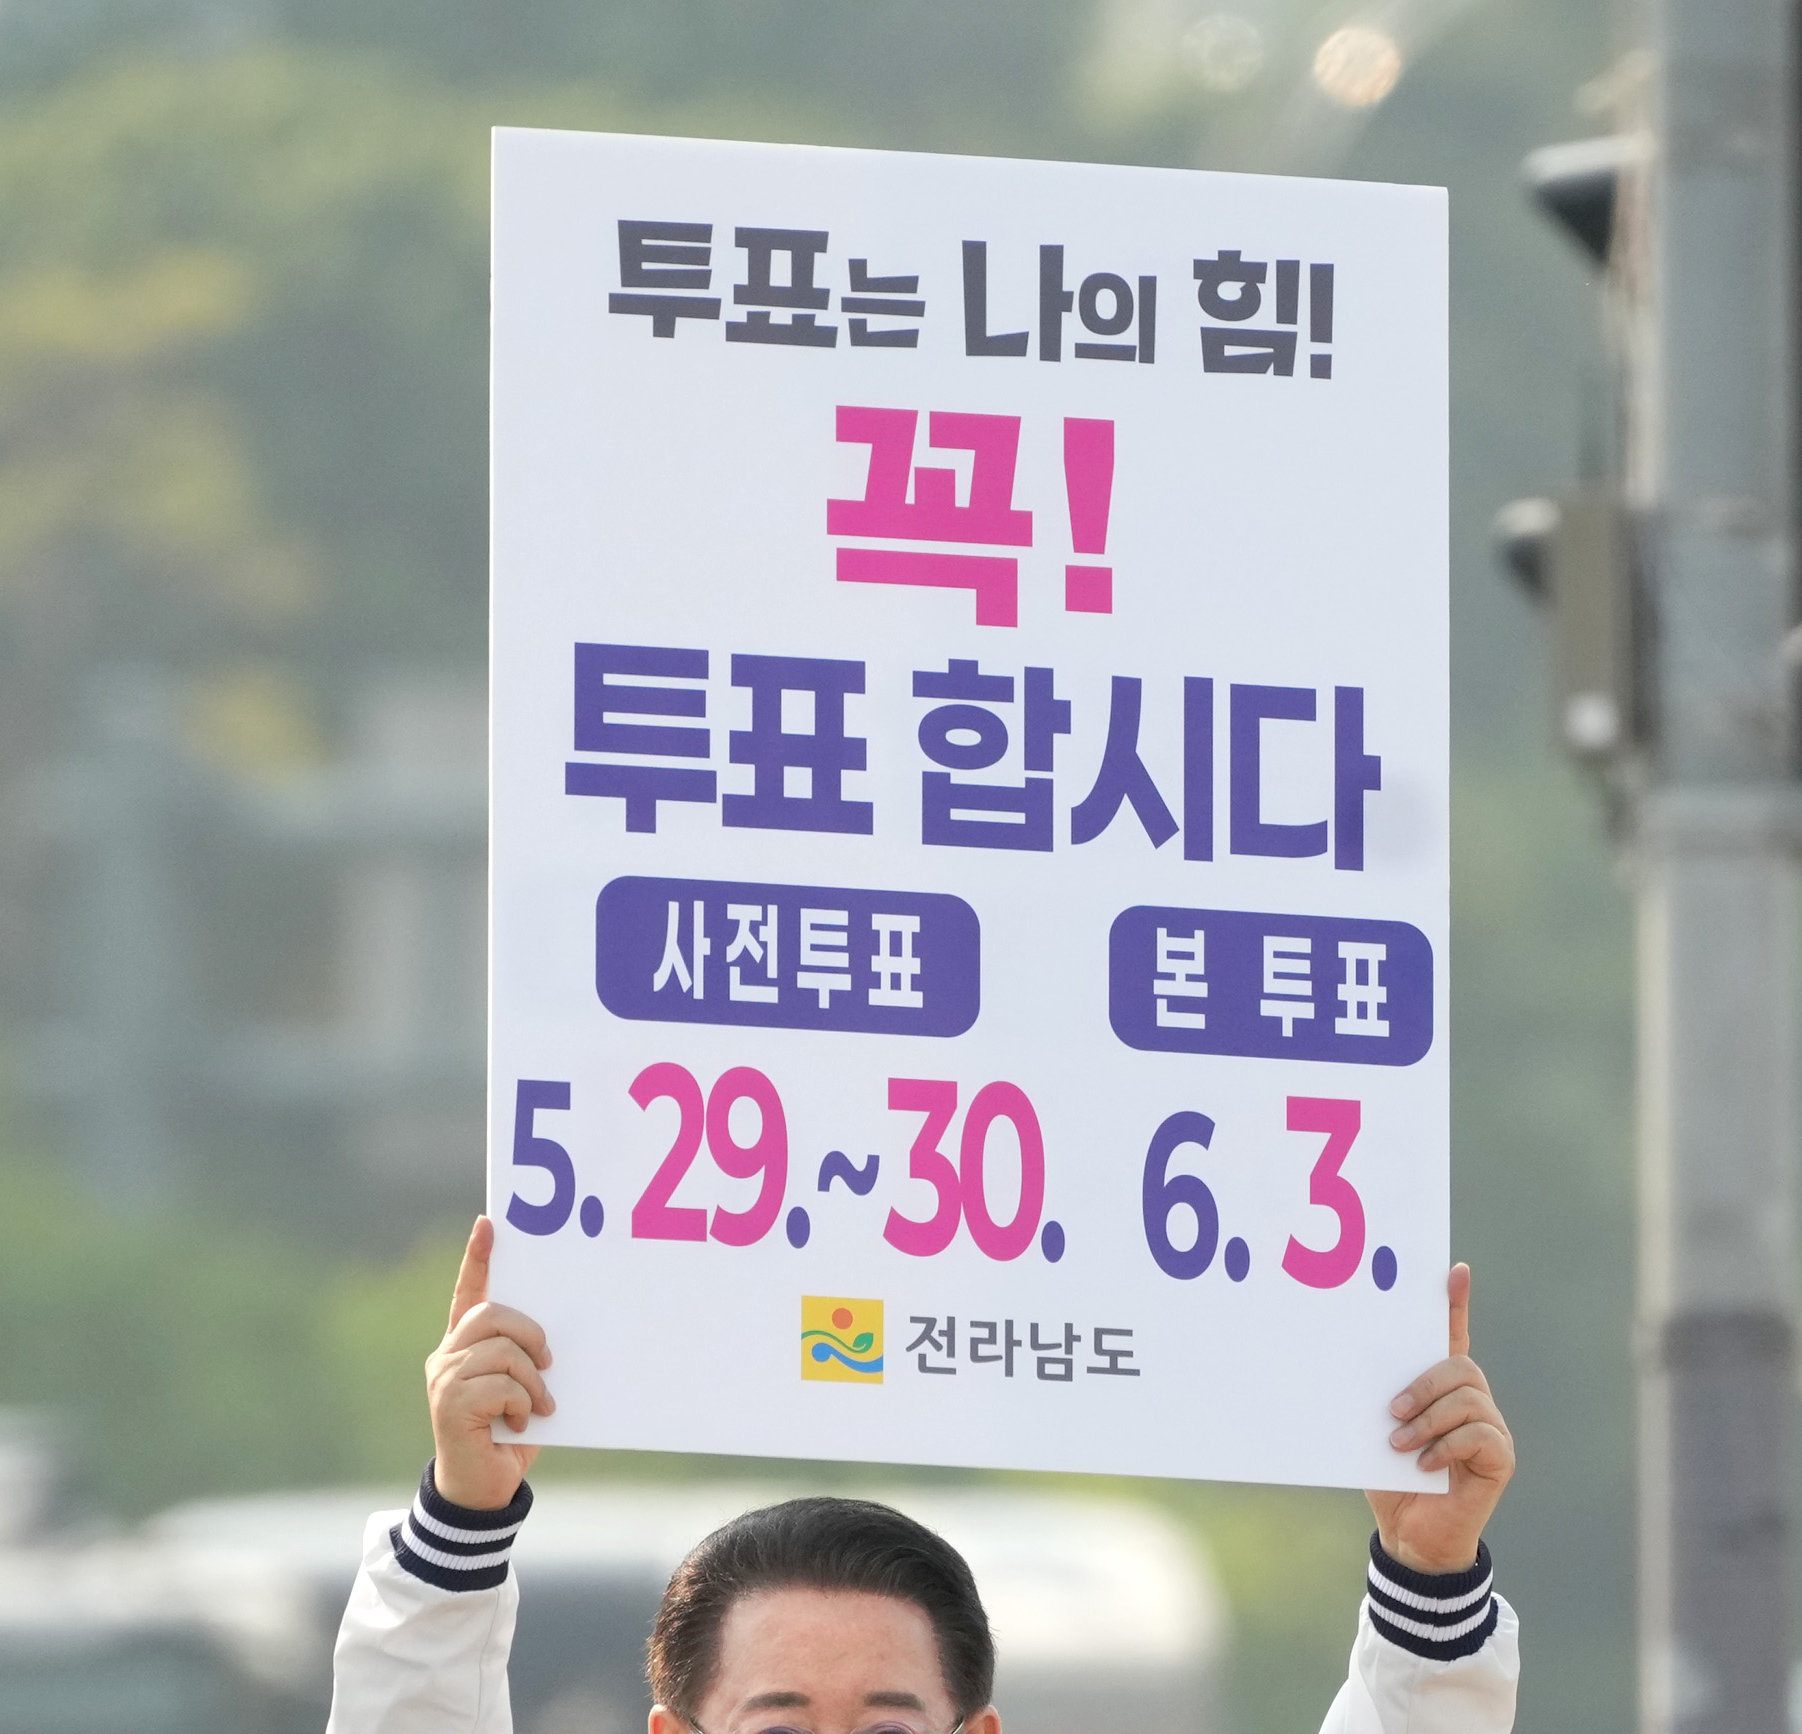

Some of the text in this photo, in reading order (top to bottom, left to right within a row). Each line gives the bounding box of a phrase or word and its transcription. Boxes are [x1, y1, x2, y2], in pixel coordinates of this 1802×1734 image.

[609, 220, 1334, 379] 투표는 나의 힘!
[827, 406, 1114, 627] 꼭!
[565, 642, 1381, 871] 투표 합시다
[654, 901, 923, 1008] 사전투표
[1154, 928, 1389, 1037] 본 투표
[906, 1316, 1140, 1381] 전라남도
